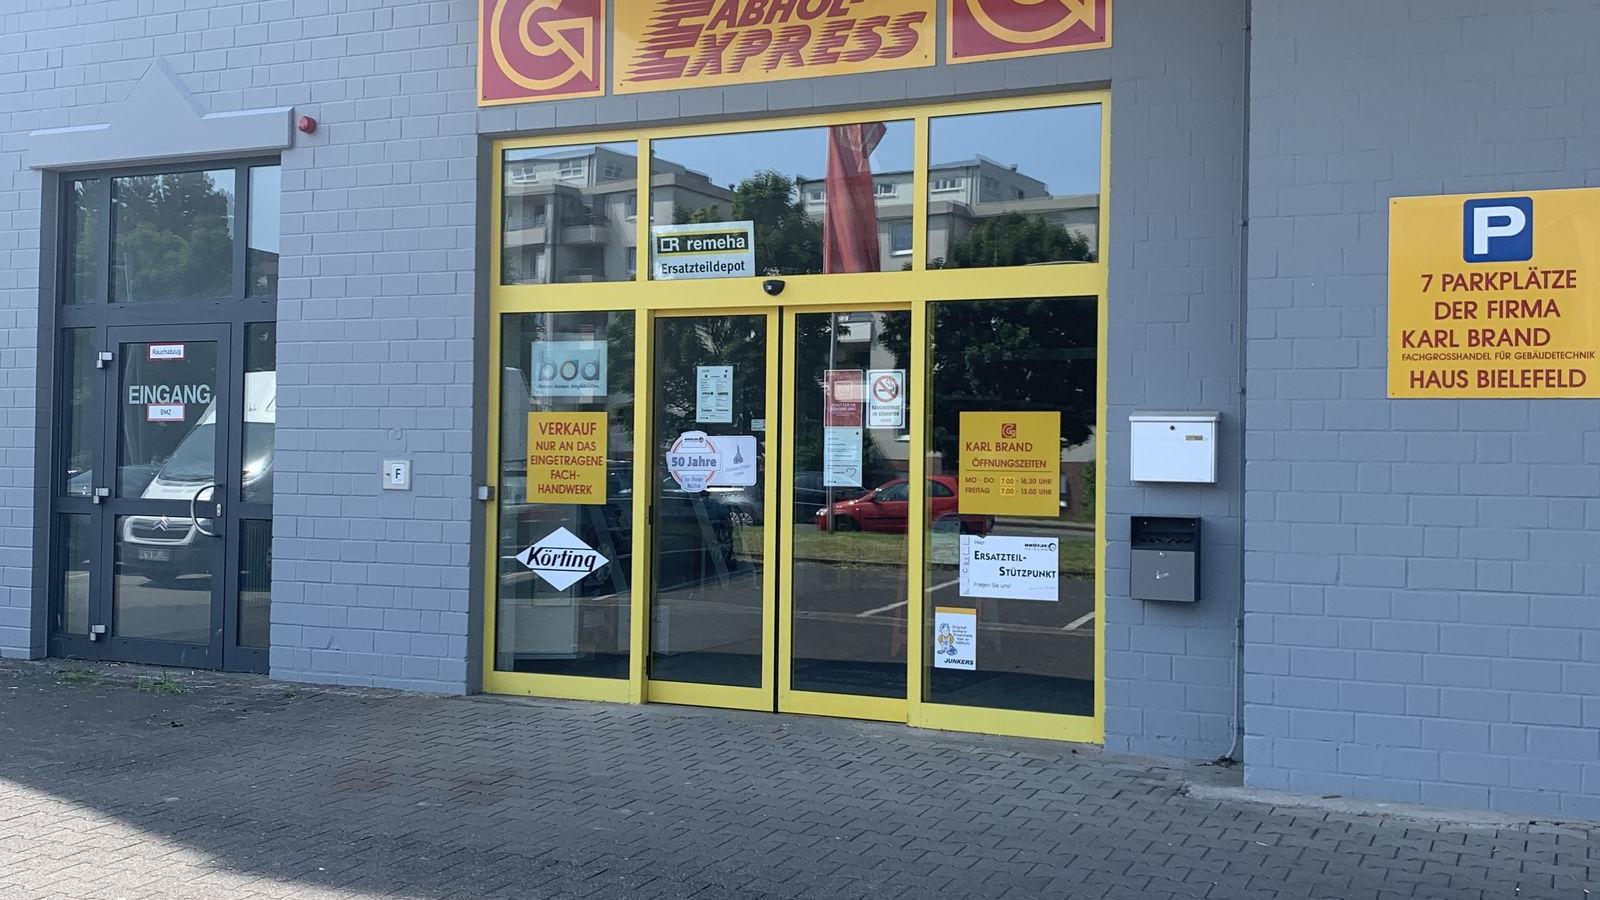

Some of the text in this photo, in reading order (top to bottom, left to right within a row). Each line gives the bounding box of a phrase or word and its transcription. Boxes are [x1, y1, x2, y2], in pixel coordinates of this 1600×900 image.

[1473, 205, 1526, 255] P
[687, 234, 746, 251] remeha
[661, 260, 746, 274] Ersatzteildepot
[1421, 267, 1577, 292] 7 PARKPLÄTZE
[1434, 299, 1561, 320] DER FIRMA
[1401, 327, 1551, 349] KARL BRAND
[1401, 350, 1596, 361] FACHGROSSHANDEL FÜR GEBÄUDETECHNIK
[1409, 368, 1587, 389] HAUS BIELEFELD
[128, 384, 211, 405] EINGANG
[538, 422, 597, 436] VERKAUF
[535, 441, 597, 451] NUR AN DAS
[965, 441, 1033, 452] KARL BRAND
[530, 455, 604, 466] EINGETRAGENE
[671, 455, 717, 467] 50 Jahre
[971, 457, 1047, 468] ÖFFNUNGSZEITEN
[395, 468, 402, 479] F
[550, 469, 580, 481] FACH-
[537, 483, 593, 495] HANDWERK
[1038, 488, 1052, 496] UHR
[526, 545, 597, 572] Körting
[974, 550, 1027, 562] ERSATZTEIL-
[998, 566, 1057, 579] STÜTZPUNKT
[944, 657, 974, 666] JUNKERS
